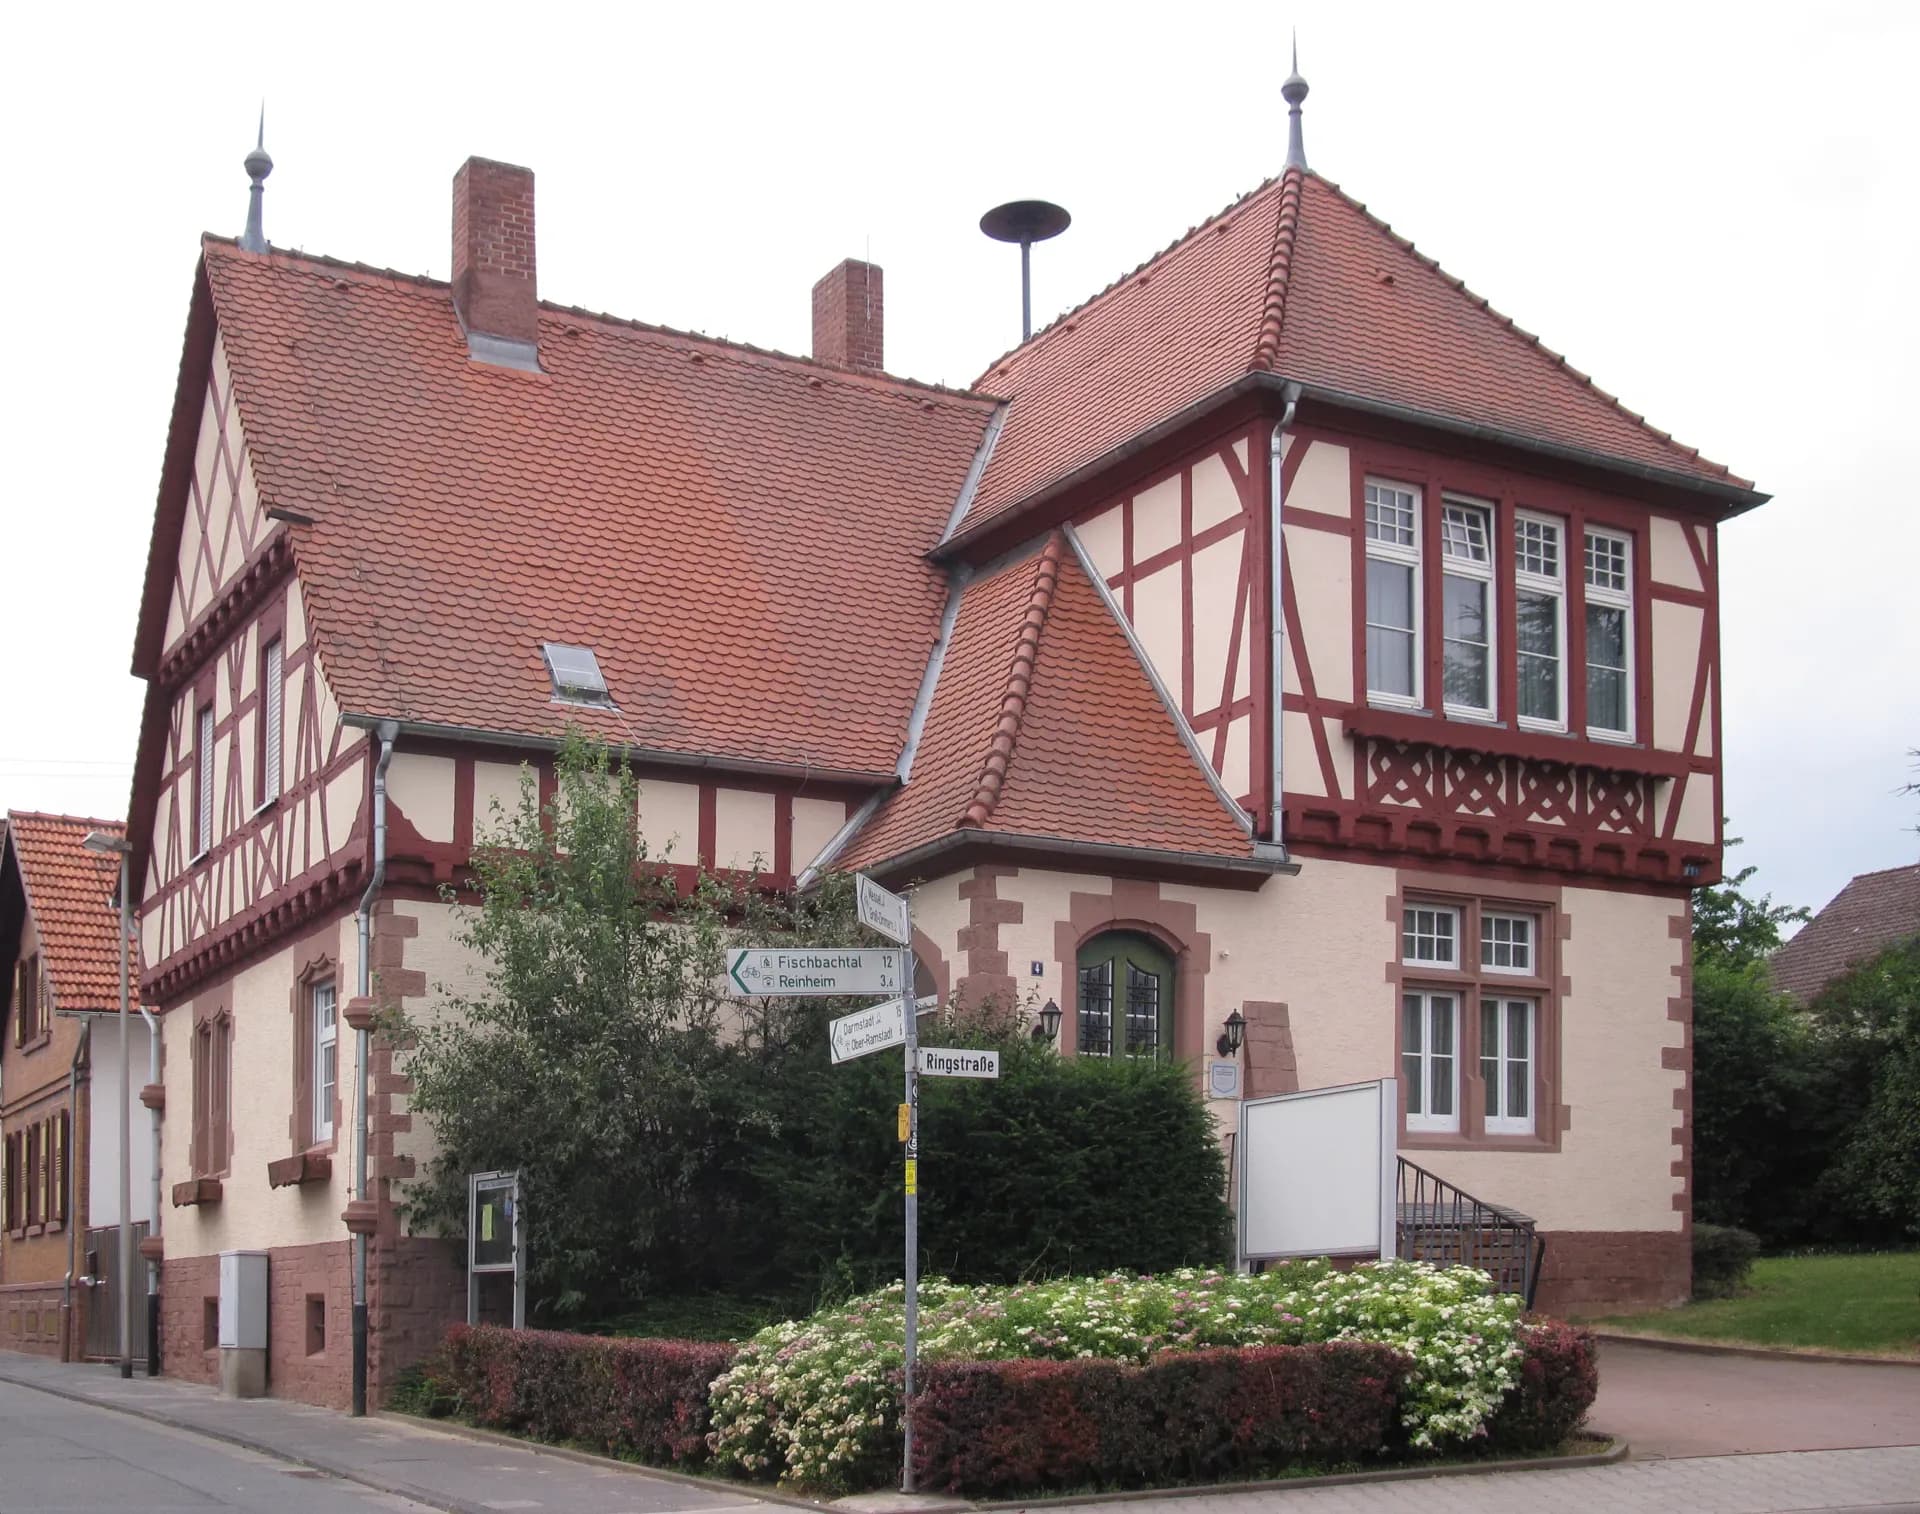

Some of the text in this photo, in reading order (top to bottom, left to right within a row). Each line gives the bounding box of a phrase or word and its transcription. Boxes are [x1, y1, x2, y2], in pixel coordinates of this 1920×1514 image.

[778, 955, 893, 969] Fischbachtal 12
[779, 974, 836, 988] Reinheim
[843, 1014, 875, 1036] Darmstadt
[851, 1026, 893, 1051] Ober-Ramstadt
[926, 1053, 994, 1074] Ringstraße
